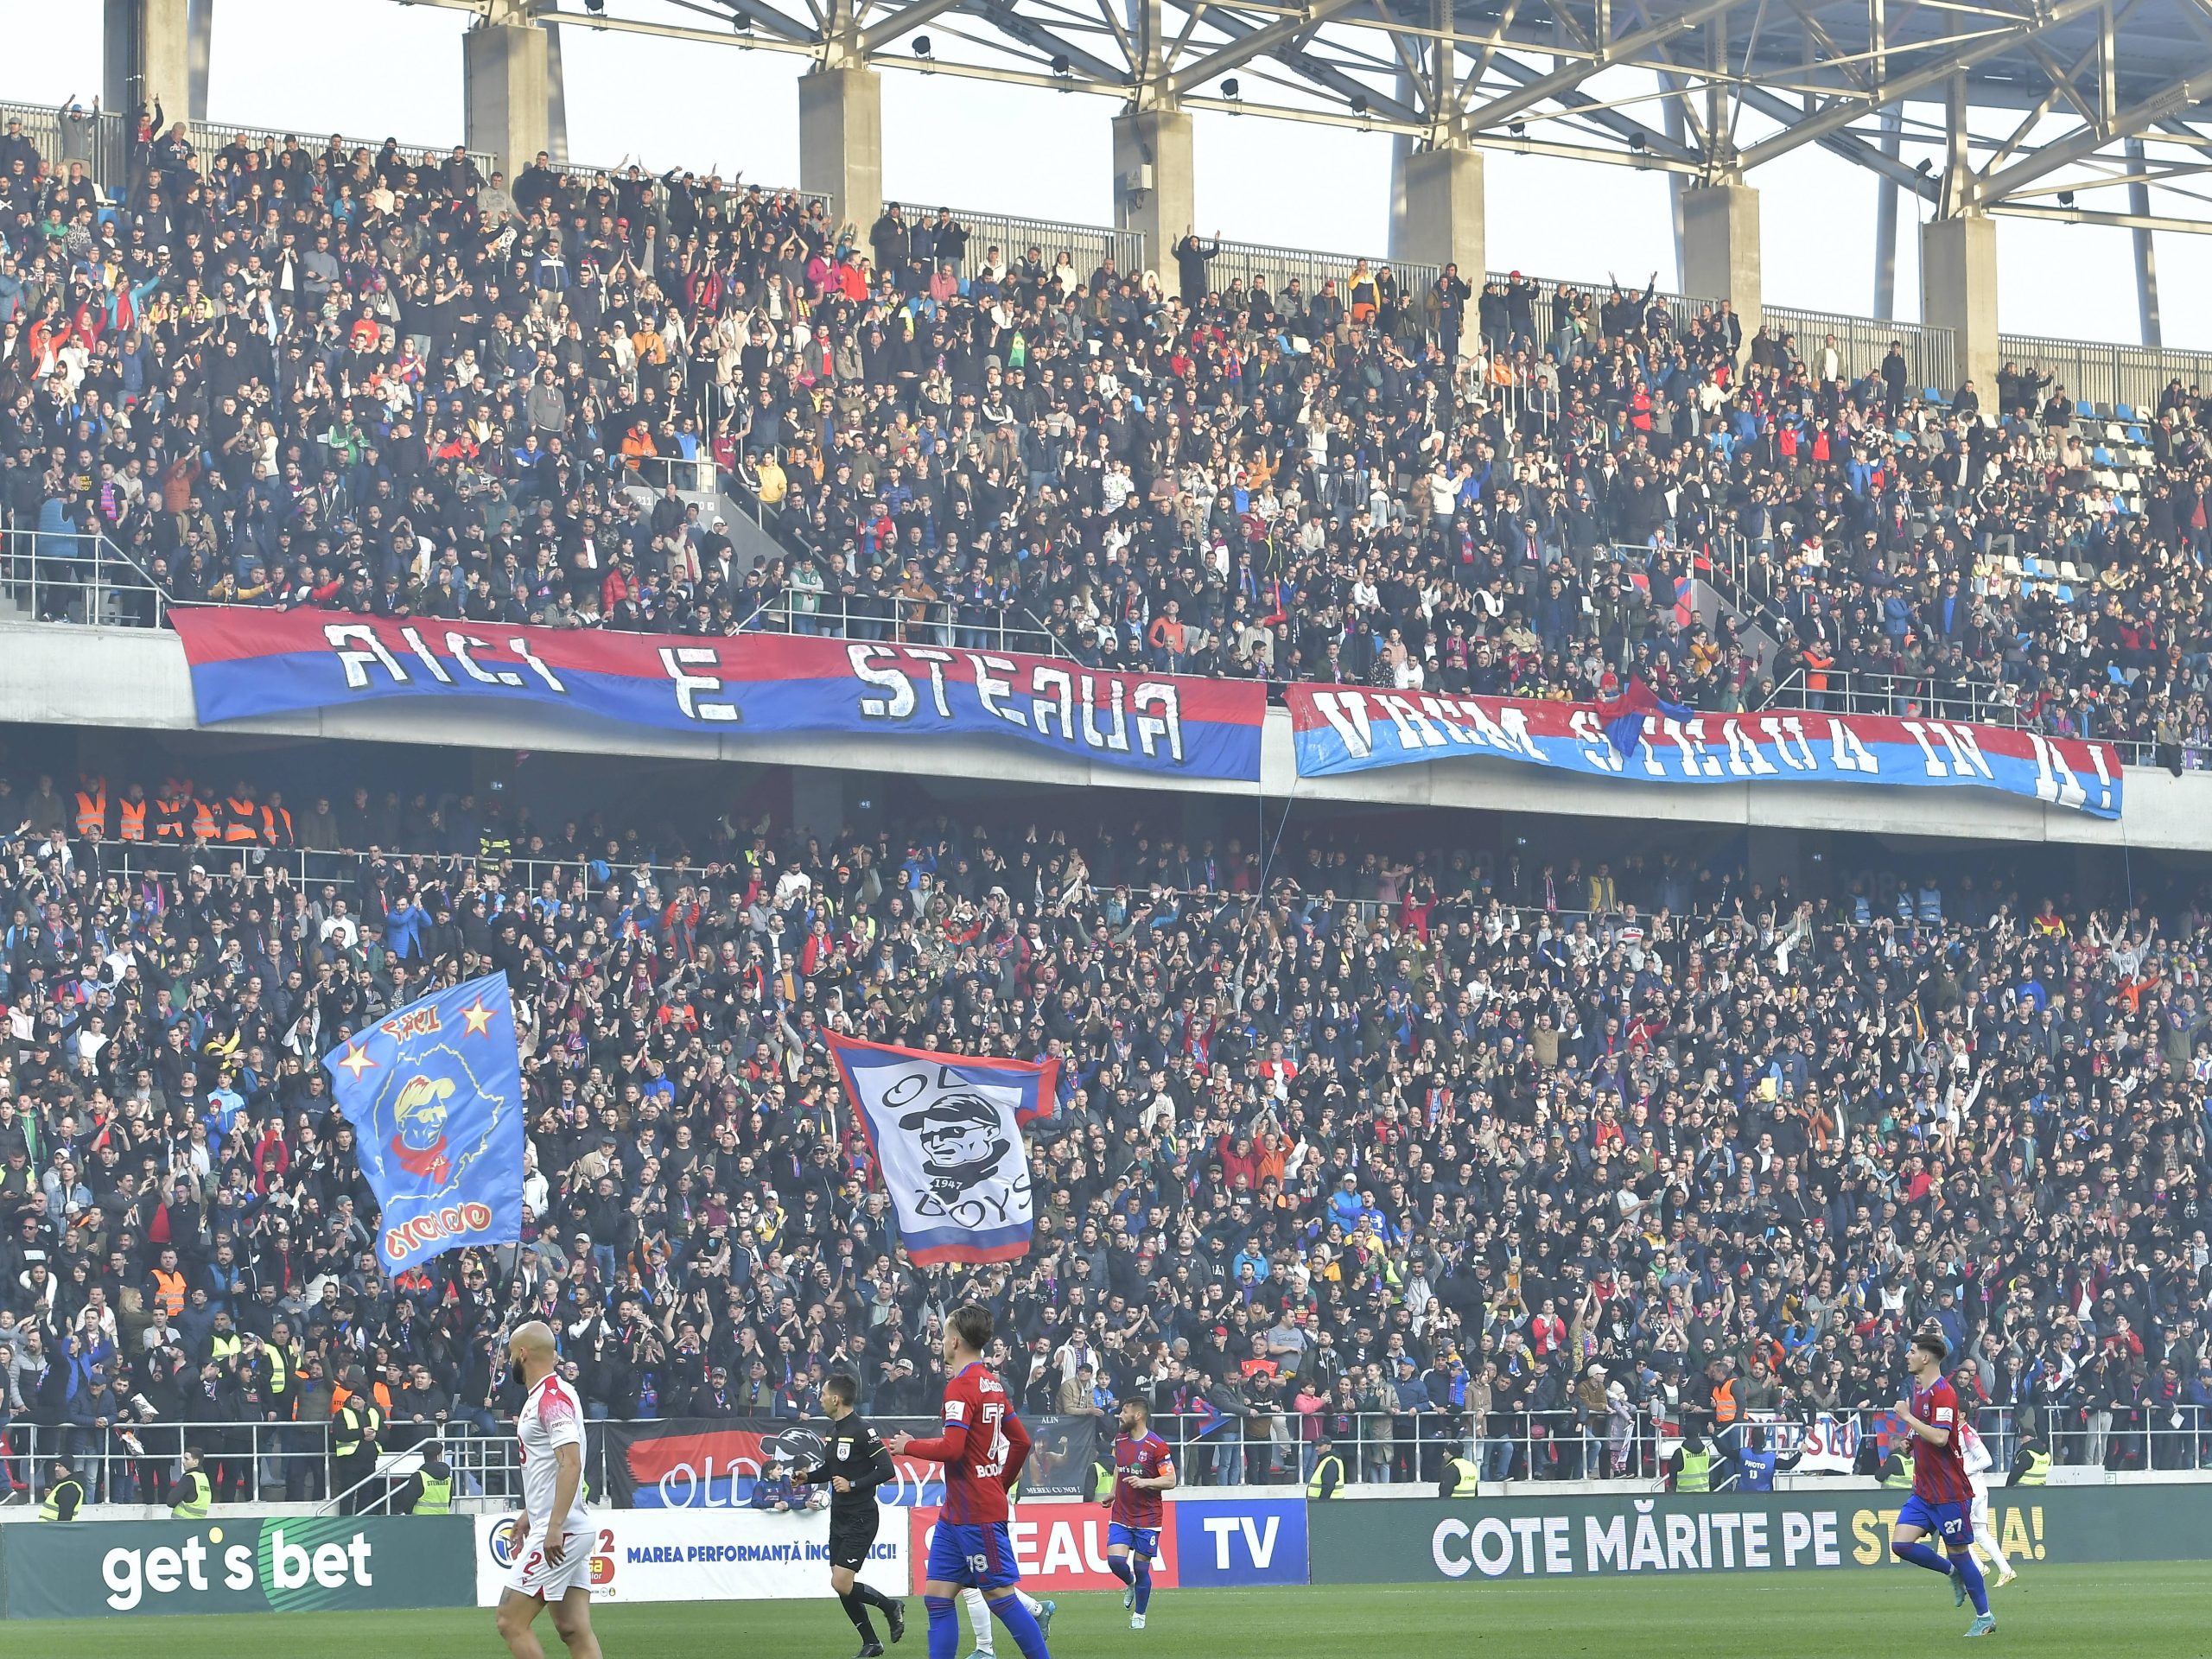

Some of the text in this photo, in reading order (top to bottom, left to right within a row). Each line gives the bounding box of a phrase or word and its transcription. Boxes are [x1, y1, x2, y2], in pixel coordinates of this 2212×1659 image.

[323, 623, 1183, 761] AICI E STEAUA
[1568, 710, 1880, 777] STEAUA
[1901, 721, 1995, 780] IN
[2024, 732, 2112, 810] A!
[881, 1065, 969, 1108] OL
[933, 1178, 963, 1191] 1947
[1116, 1465, 1143, 1476] et's bet
[1744, 1459, 1766, 1470] PHOTO
[1750, 1470, 1758, 1480] 13
[1026, 1486, 1052, 1495] MEREU
[1432, 1516, 1573, 1578] COTE
[1584, 1498, 1771, 1573] MĂRITE
[1782, 1510, 1841, 1567] PE
[1943, 1517, 1963, 1535] 27
[599, 1529, 615, 1553] 2
[1148, 1535, 1156, 1547] 8
[1203, 1516, 1281, 1570] TV
[271, 1529, 373, 1590] bet
[523, 1551, 543, 1576] 2
[627, 1546, 683, 1563] MAREA
[688, 1541, 802, 1566] PERFORMANȚĂ
